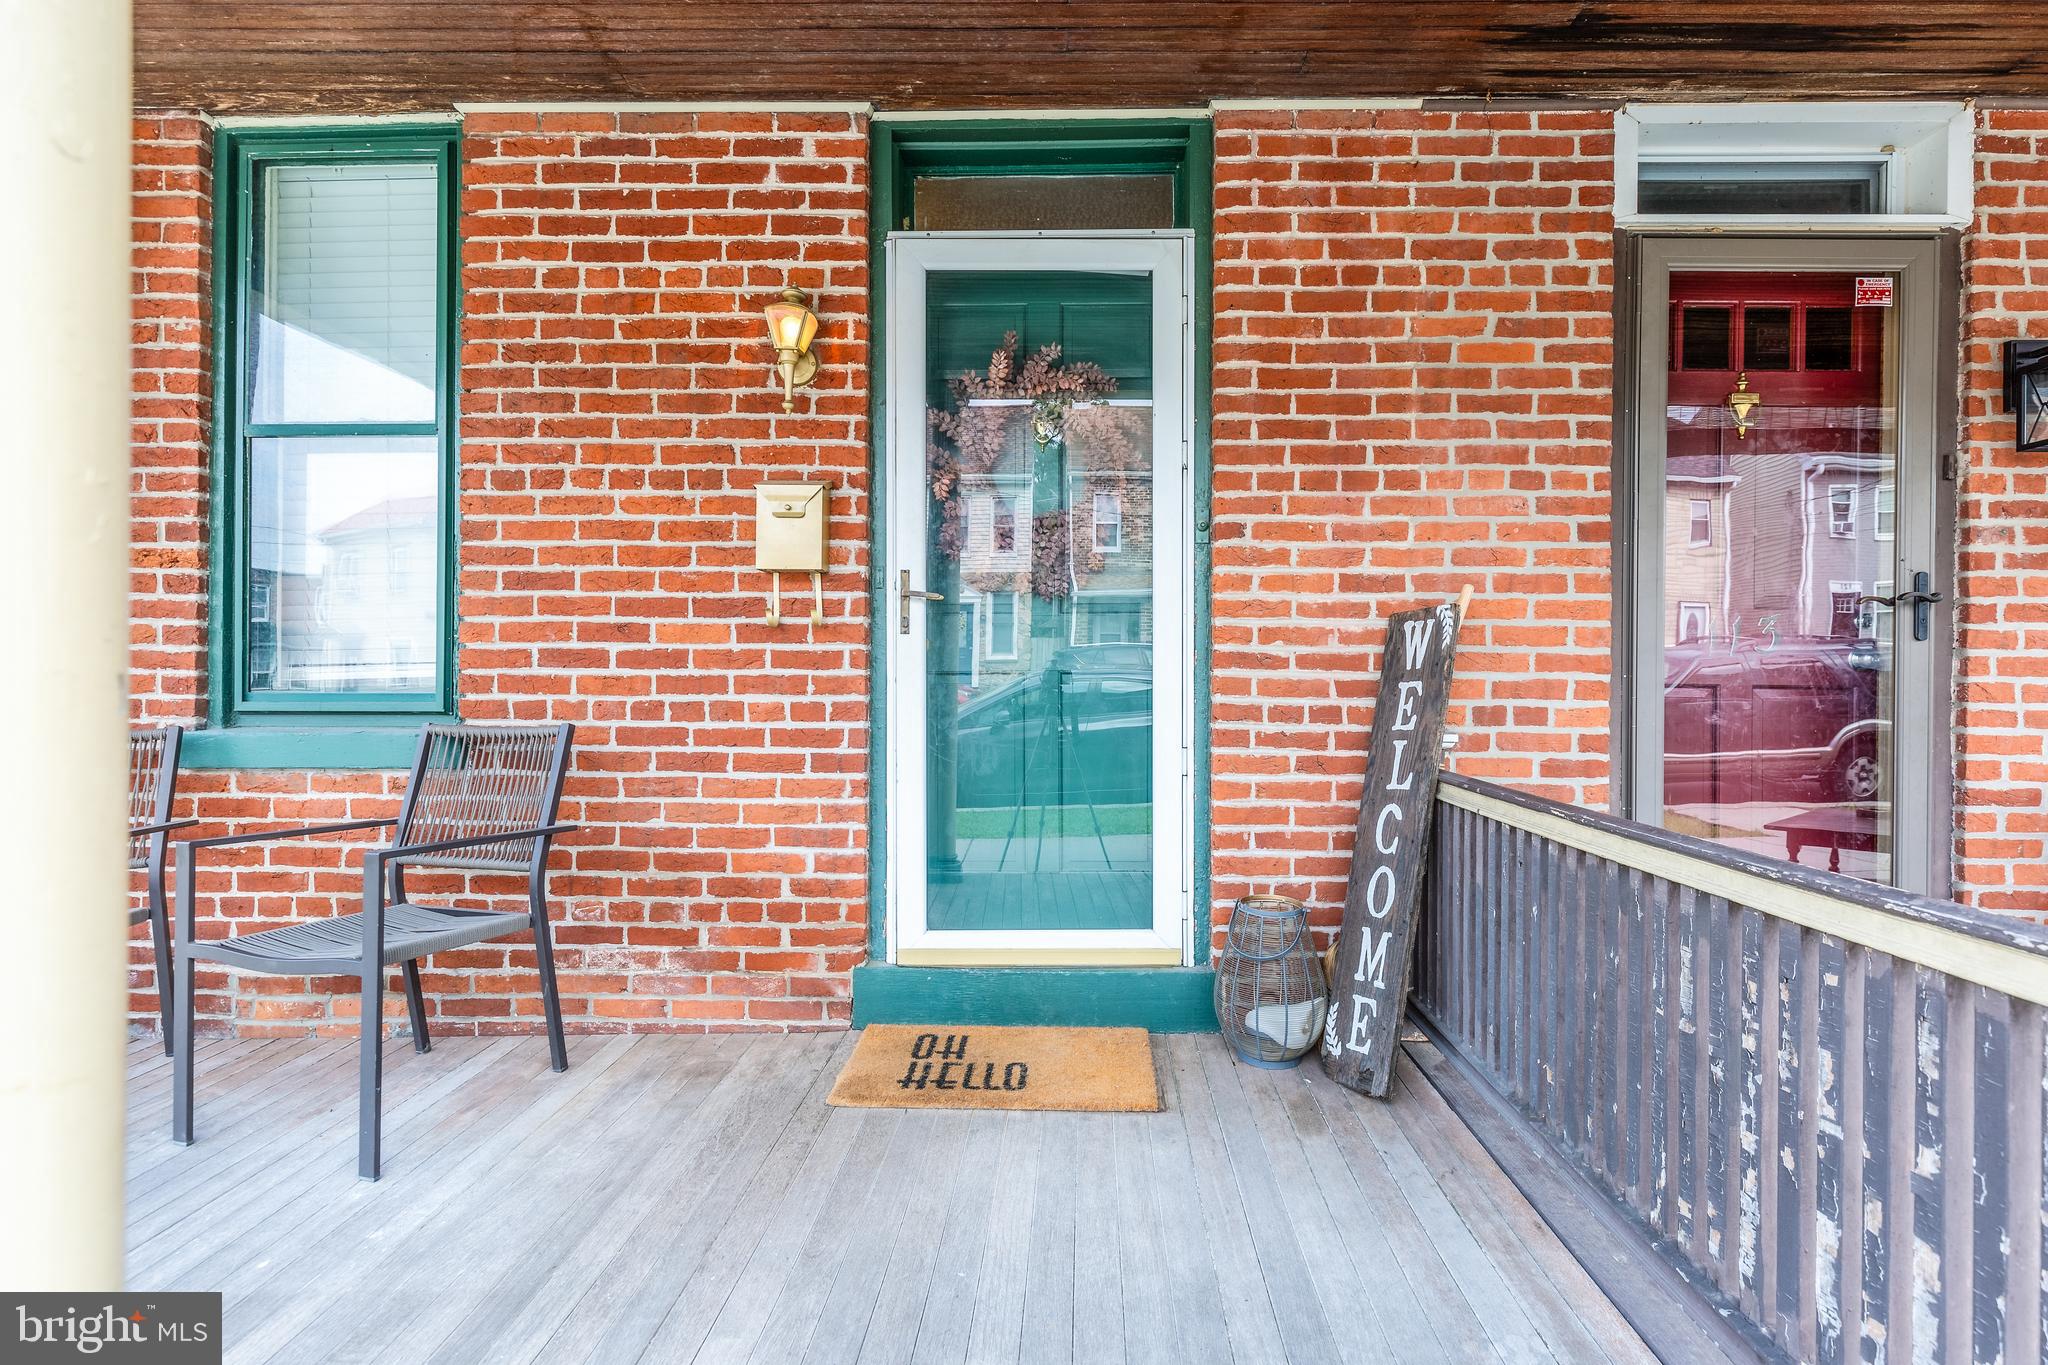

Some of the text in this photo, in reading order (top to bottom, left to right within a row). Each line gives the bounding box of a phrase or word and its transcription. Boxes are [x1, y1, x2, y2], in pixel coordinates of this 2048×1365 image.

[1346, 618, 1434, 1056] WELCOME
[911, 1033, 969, 1060] OH
[896, 1061, 1028, 1091] HELLO
